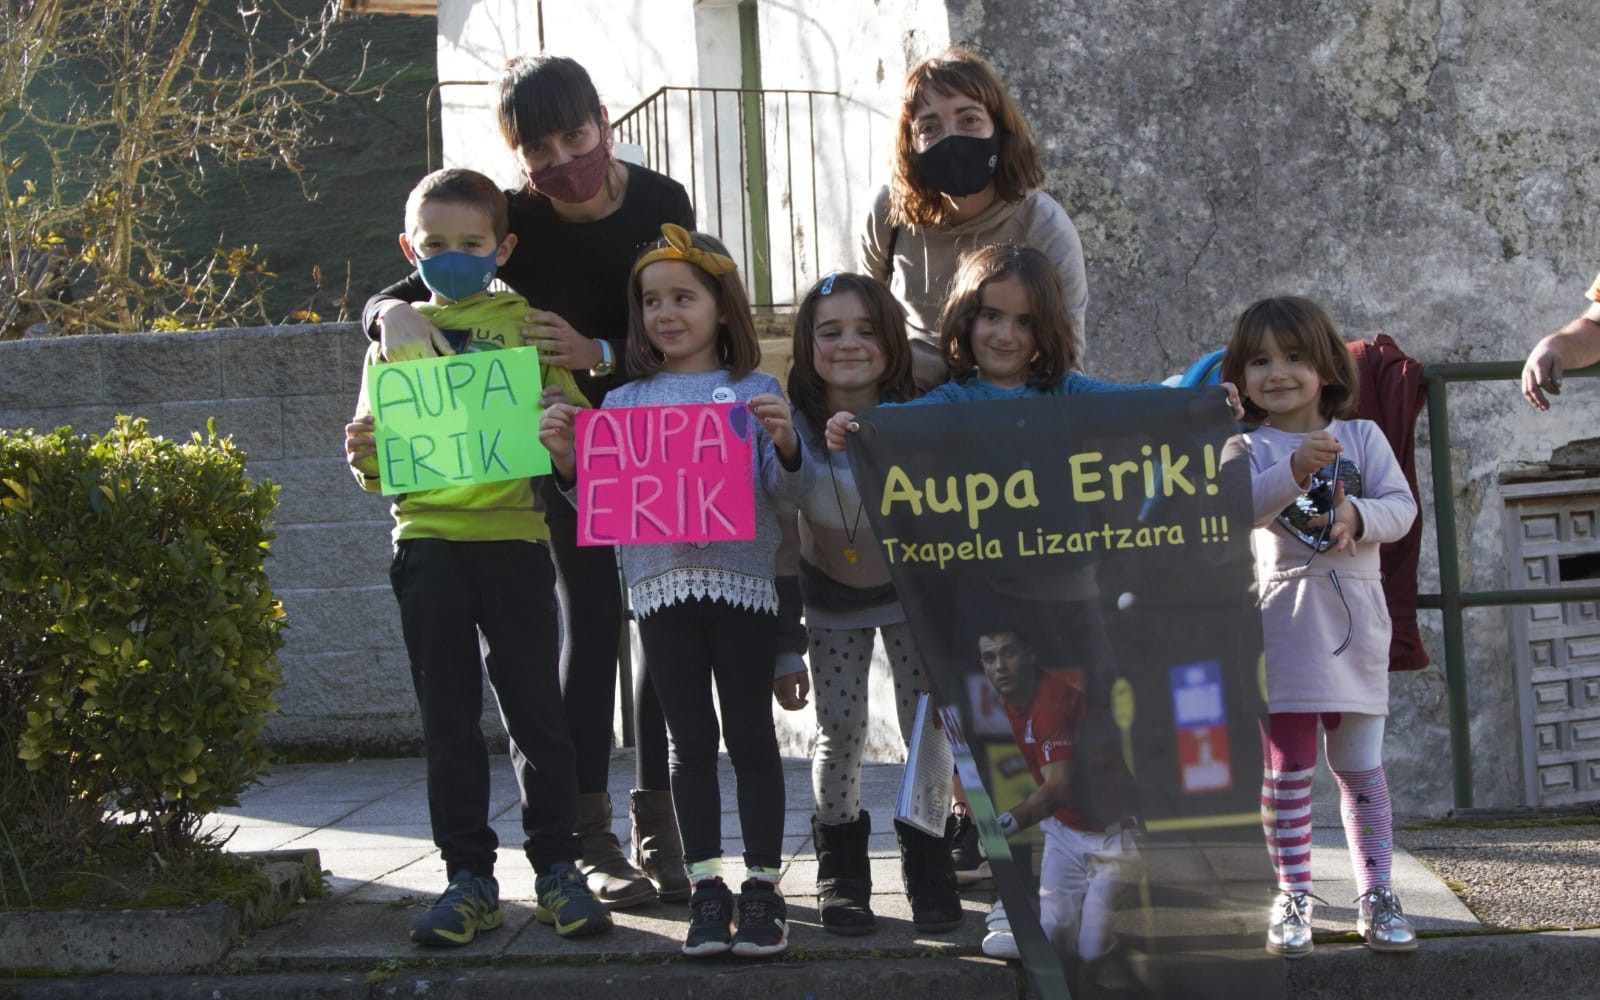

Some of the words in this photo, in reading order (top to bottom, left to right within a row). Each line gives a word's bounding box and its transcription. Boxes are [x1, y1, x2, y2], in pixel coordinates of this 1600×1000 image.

[469, 328, 506, 346] UA
[376, 358, 518, 422] AUPA
[385, 429, 510, 488] ERIK
[583, 407, 729, 472] AUPA
[880, 465, 1040, 530] Aupa
[1068, 443, 1220, 502] Erik!
[882, 533, 1003, 570] Txapela
[1017, 523, 1185, 557] Lizartzara
[1200, 515, 1230, 544] !!!
